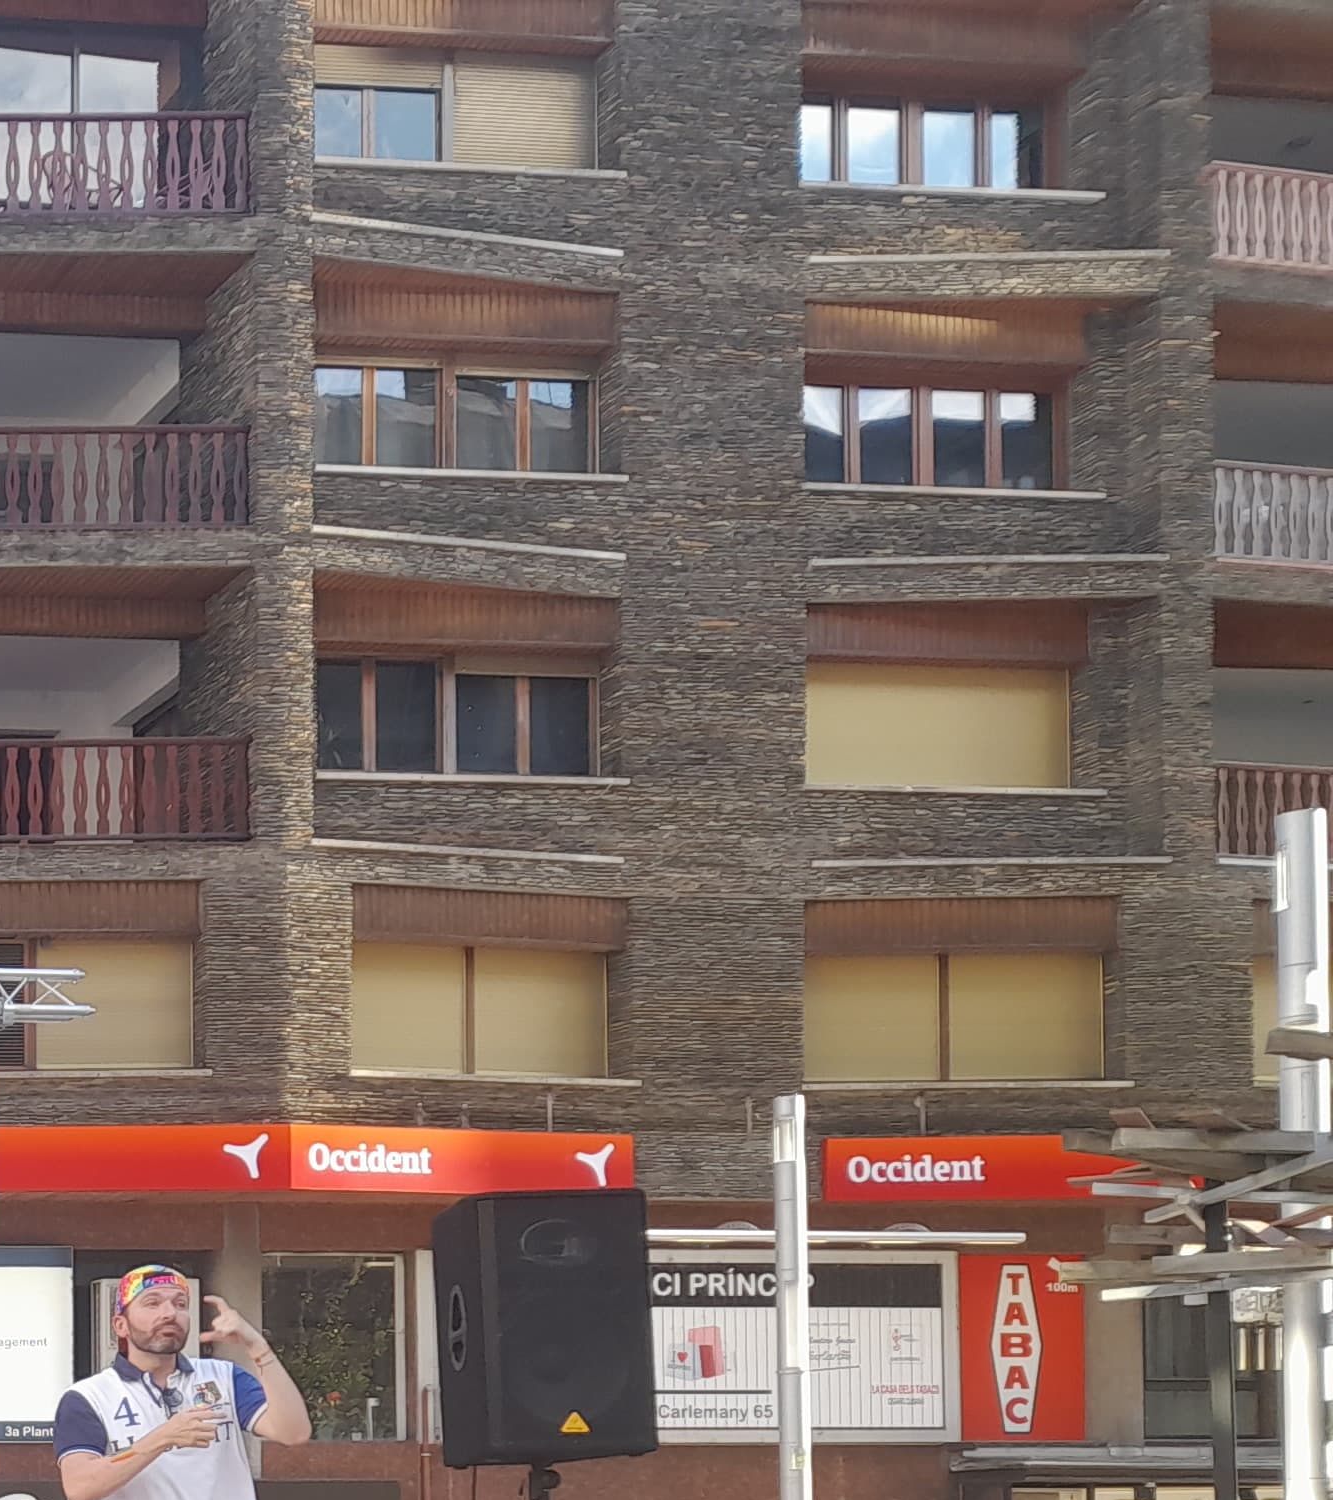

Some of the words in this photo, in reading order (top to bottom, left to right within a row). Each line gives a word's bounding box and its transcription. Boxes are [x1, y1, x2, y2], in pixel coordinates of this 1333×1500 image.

[308, 1142, 432, 1175] Occident
[847, 1153, 985, 1184] Occident
[1000, 1272, 1033, 1424] TABAC
[114, 1397, 141, 1427] 4
[658, 1404, 749, 1422] Carlemany
[753, 1404, 773, 1418] 65
